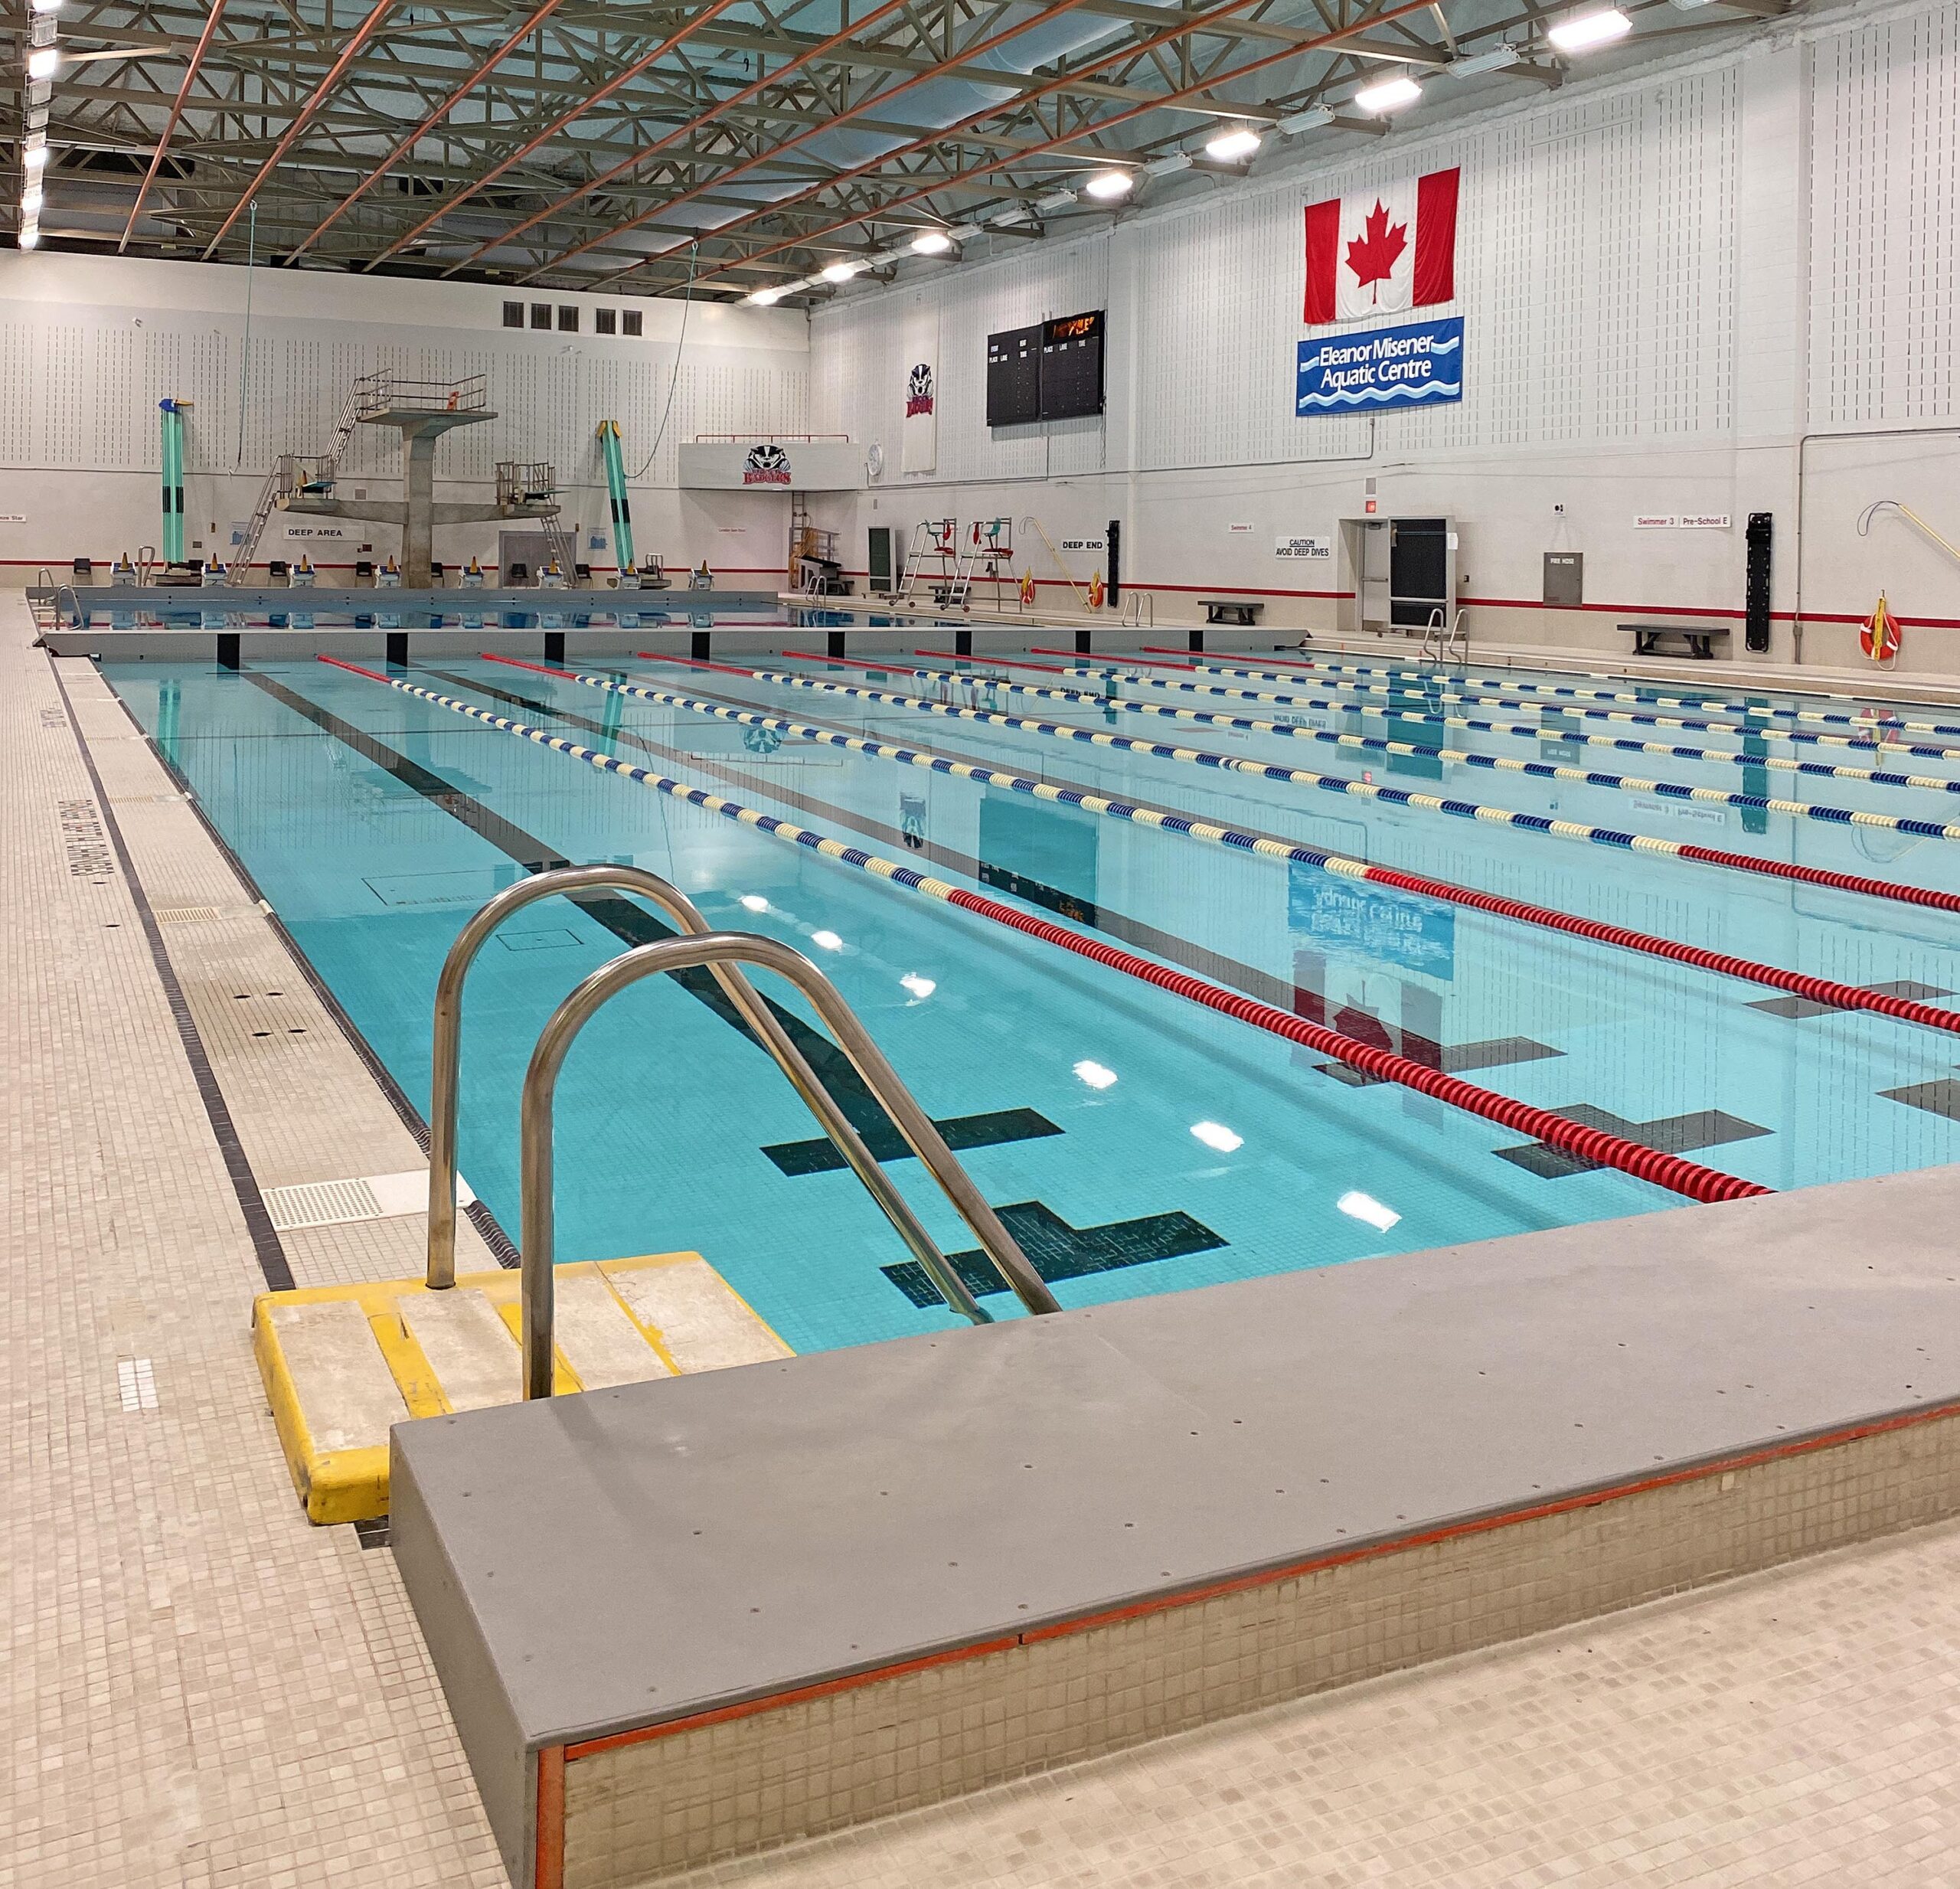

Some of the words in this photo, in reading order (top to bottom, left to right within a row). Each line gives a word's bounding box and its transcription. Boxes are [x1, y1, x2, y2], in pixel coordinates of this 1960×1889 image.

[1320, 345, 1372, 366] Eleanor
[1373, 335, 1434, 359] Misener
[1321, 363, 1375, 391] Aquatic
[1378, 358, 1432, 381] Centre
[1638, 517, 1668, 525] Swimmer
[1683, 517, 1721, 525] Pre-School
[288, 528, 313, 537] DEEP
[1063, 541, 1083, 549] DEEP
[1086, 541, 1103, 549] END
[1276, 547, 1292, 556] AVOID
[1294, 547, 1309, 556] DEEP
[1312, 547, 1329, 557] DIVES
[67, 845, 116, 876] CHANGES
